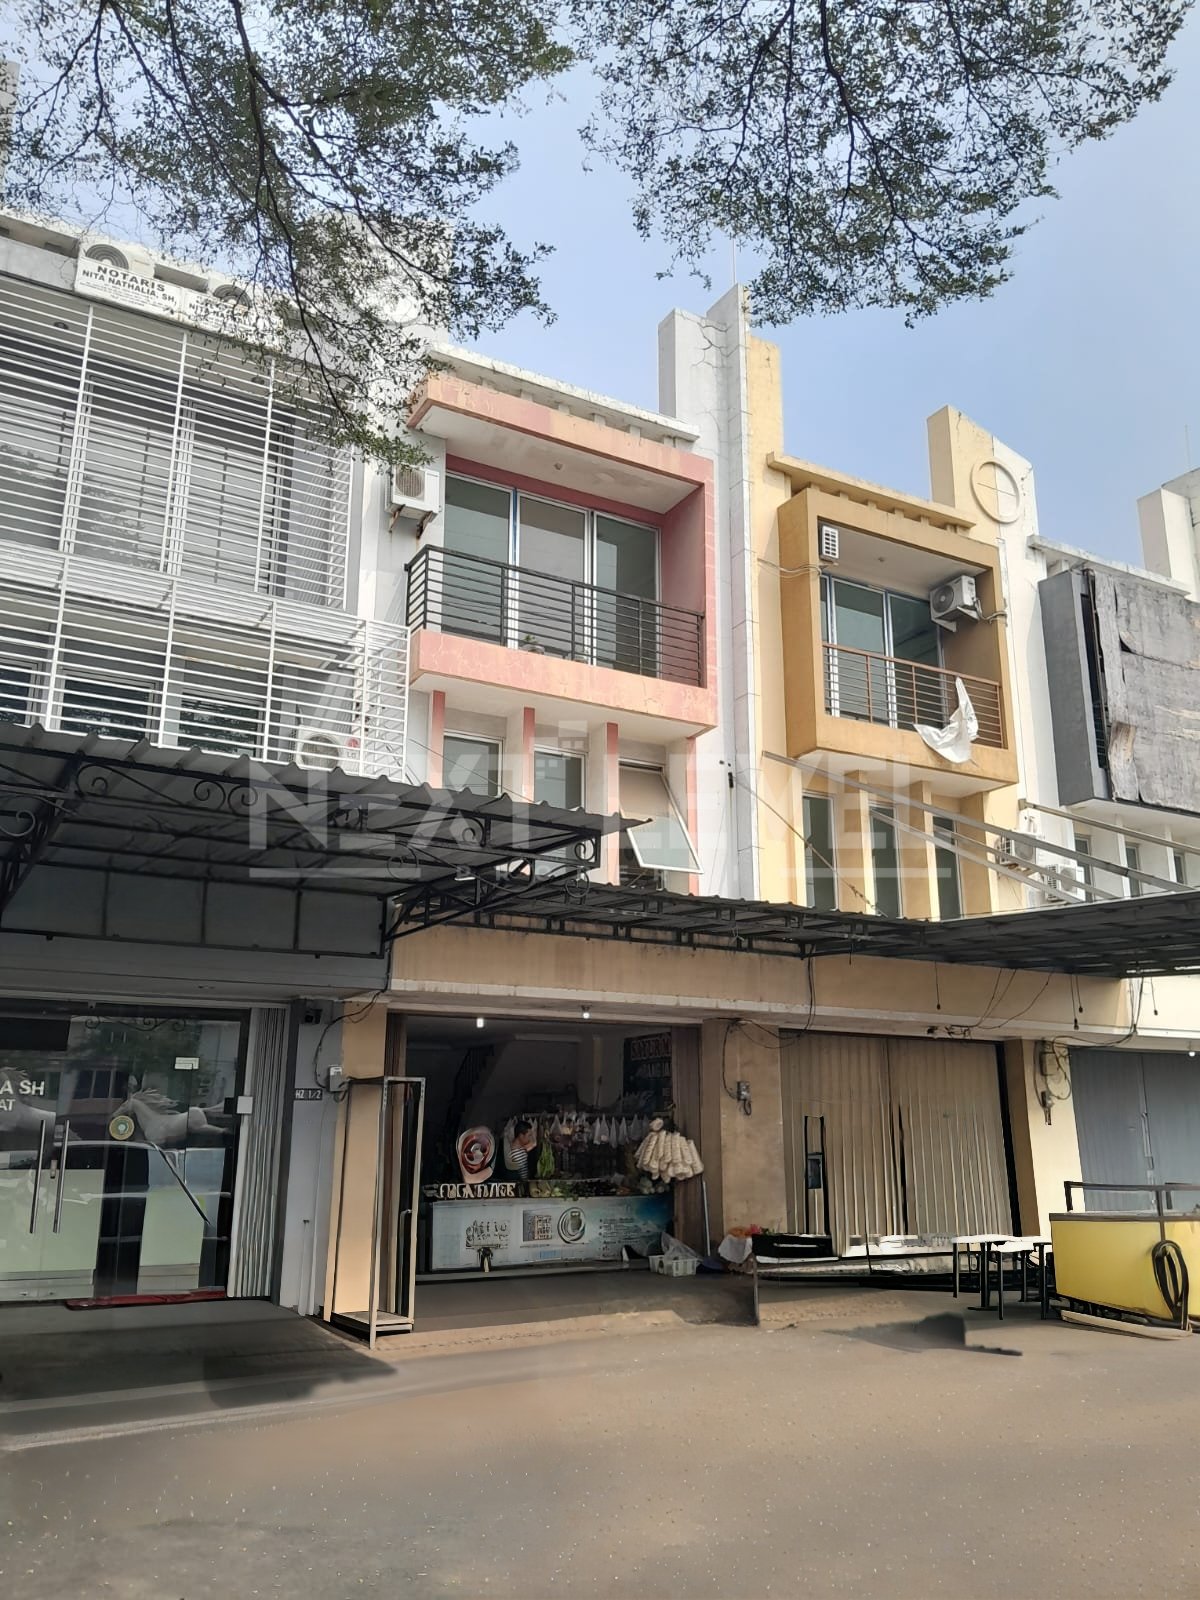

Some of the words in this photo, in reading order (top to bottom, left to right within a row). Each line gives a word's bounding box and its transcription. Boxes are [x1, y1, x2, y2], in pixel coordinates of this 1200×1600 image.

[82, 269, 105, 282] NITA
[97, 265, 165, 292] NOTARIS
[18, 1079, 45, 1096] SH
